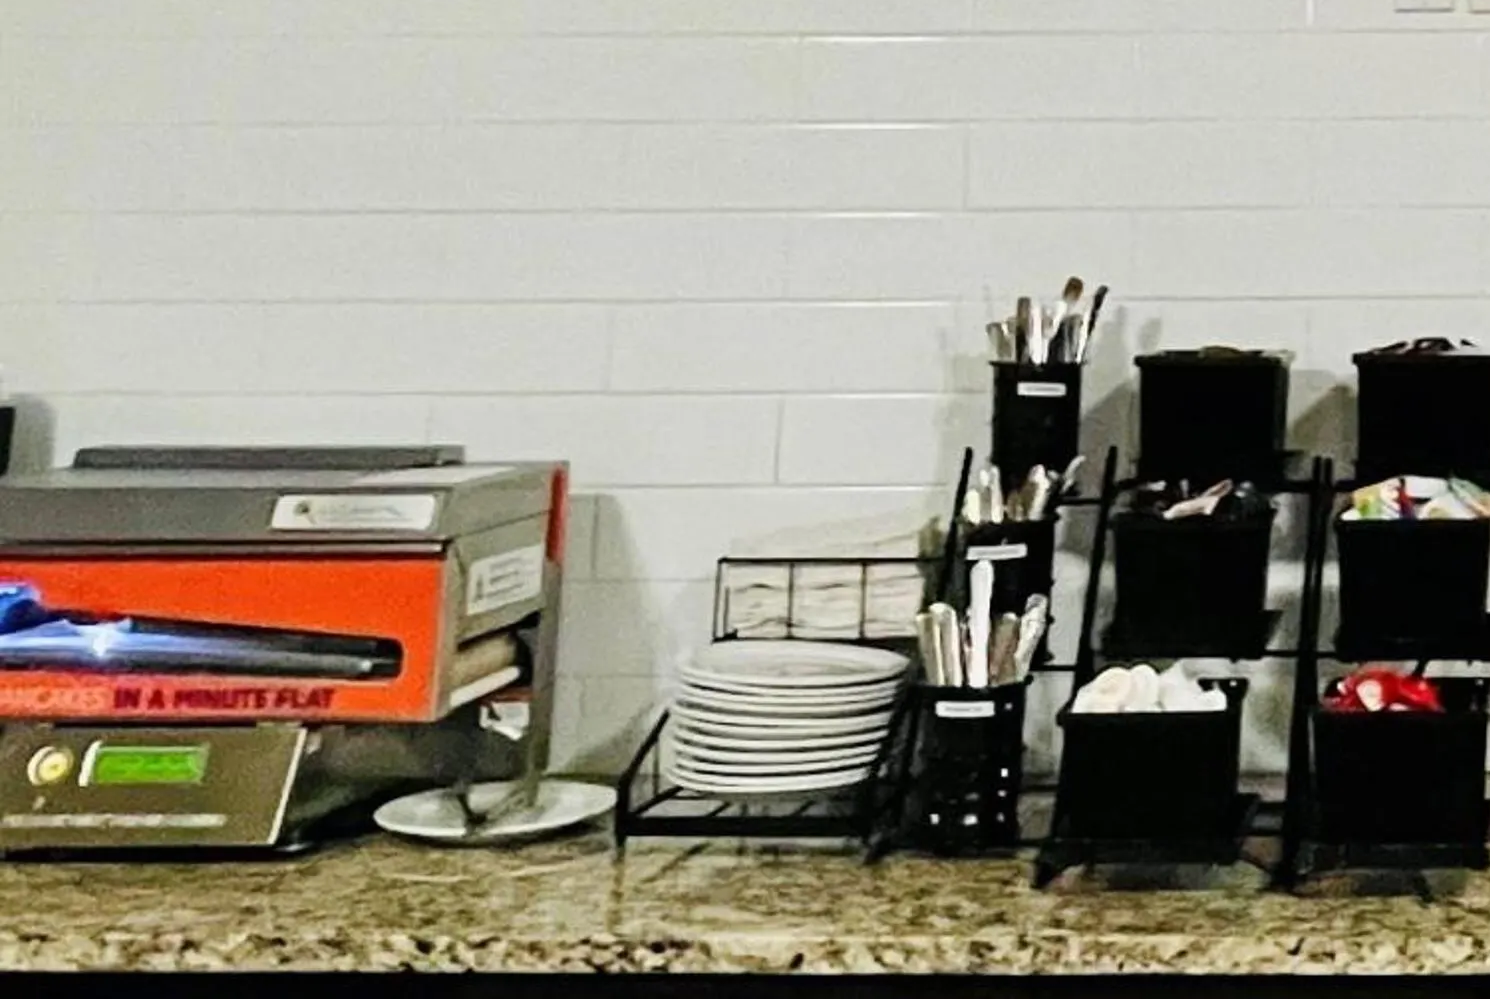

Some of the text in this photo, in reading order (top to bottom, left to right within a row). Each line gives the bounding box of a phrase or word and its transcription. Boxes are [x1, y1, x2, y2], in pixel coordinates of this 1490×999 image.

[113, 687, 141, 710] IN
[147, 688, 165, 710] A
[173, 687, 267, 710] MINUTE
[275, 687, 336, 710] FLAT
